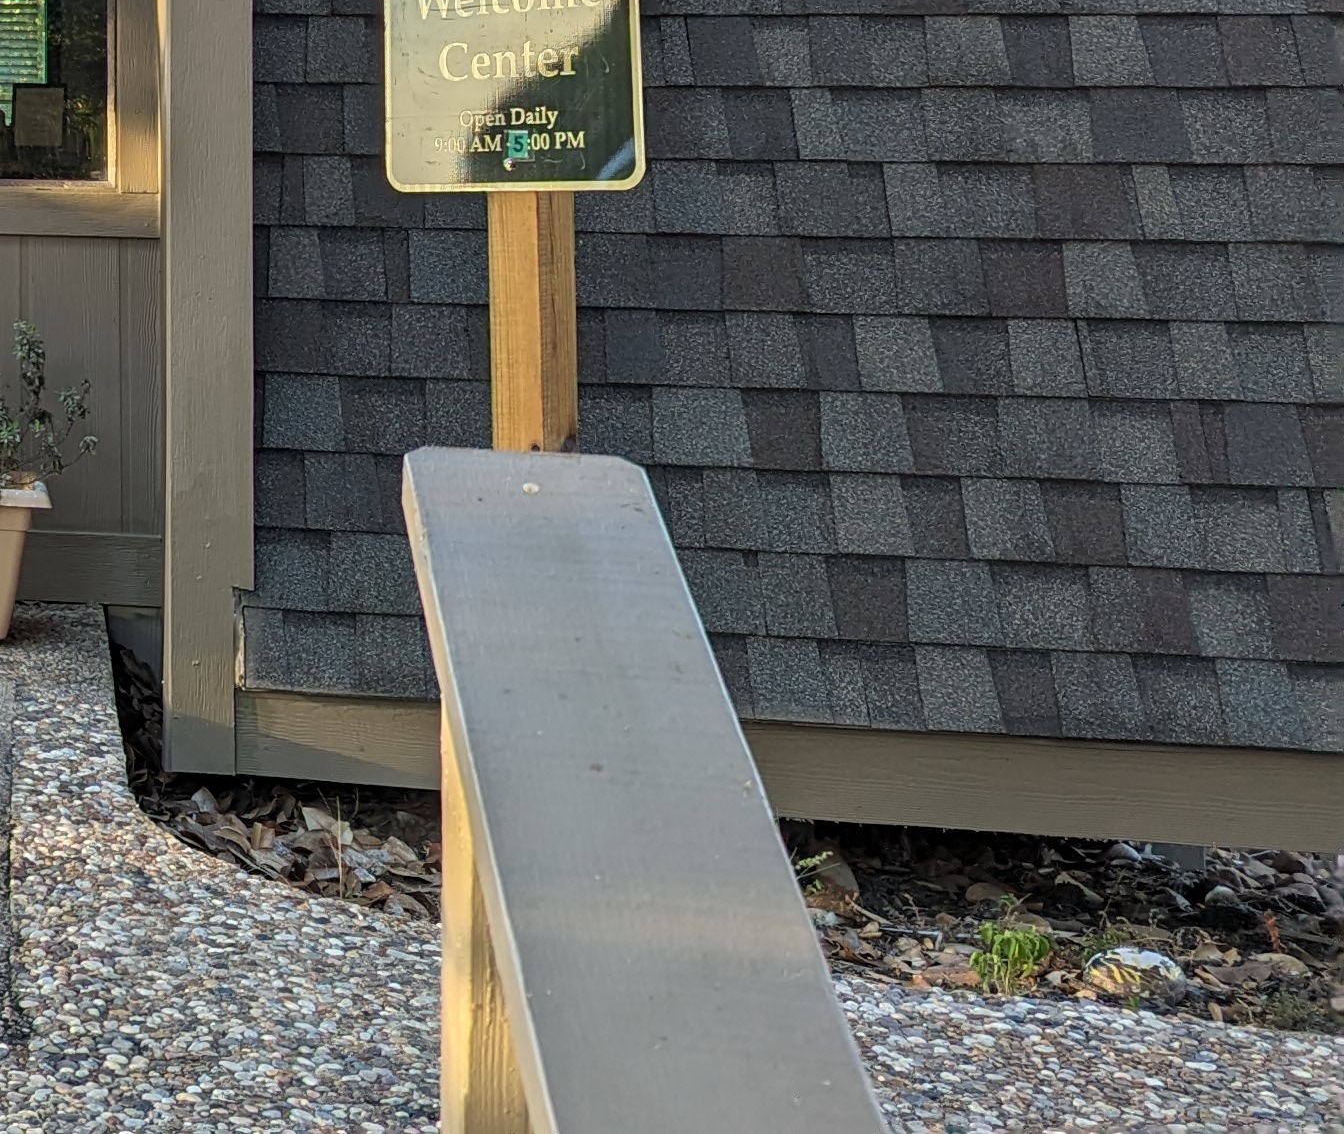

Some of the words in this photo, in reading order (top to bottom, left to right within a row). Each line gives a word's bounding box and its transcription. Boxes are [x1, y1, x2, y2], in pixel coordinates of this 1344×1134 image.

[438, 40, 580, 82] Center
[459, 110, 506, 132] Open
[510, 105, 559, 130] Daily
[434, 137, 466, 154] 9:00
[470, 134, 503, 152] AM
[554, 131, 585, 150] PM
